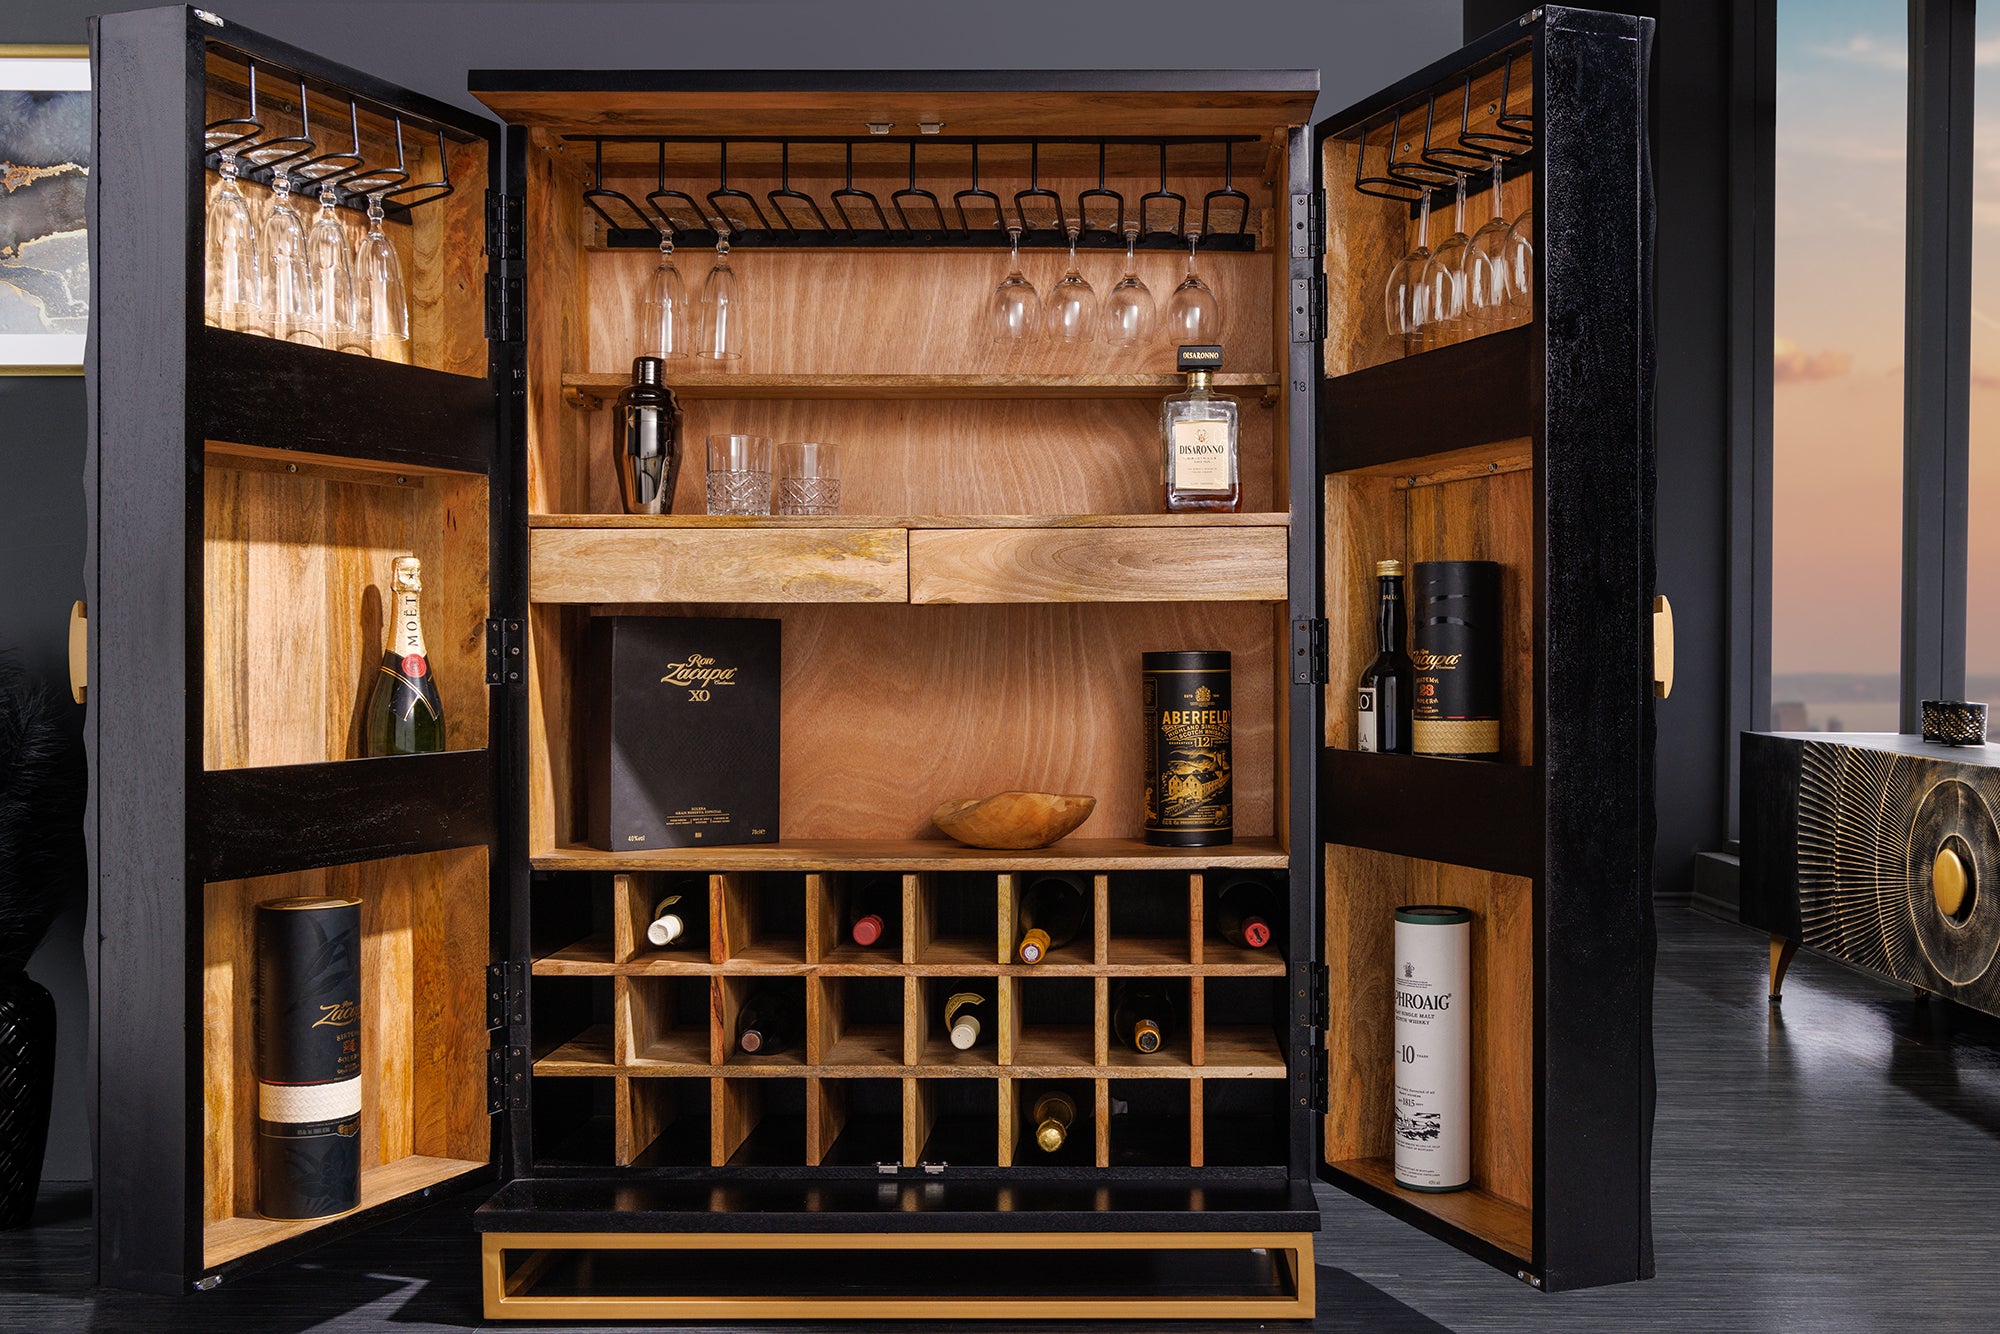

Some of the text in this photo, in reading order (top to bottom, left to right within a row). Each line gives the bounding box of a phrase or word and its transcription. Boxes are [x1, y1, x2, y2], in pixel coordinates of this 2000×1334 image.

[1182, 351, 1219, 360] DISARONNO
[1293, 380, 1306, 392] 18
[1179, 445, 1224, 455] DISARONNO
[404, 595, 418, 646] MOËT
[685, 654, 715, 667] Ron
[661, 663, 737, 688] Zacapa
[688, 689, 711, 702] XO
[1168, 724, 1200, 738] HIGHLAND
[1197, 737, 1211, 747] 12
[1402, 1044, 1415, 1064] 10
